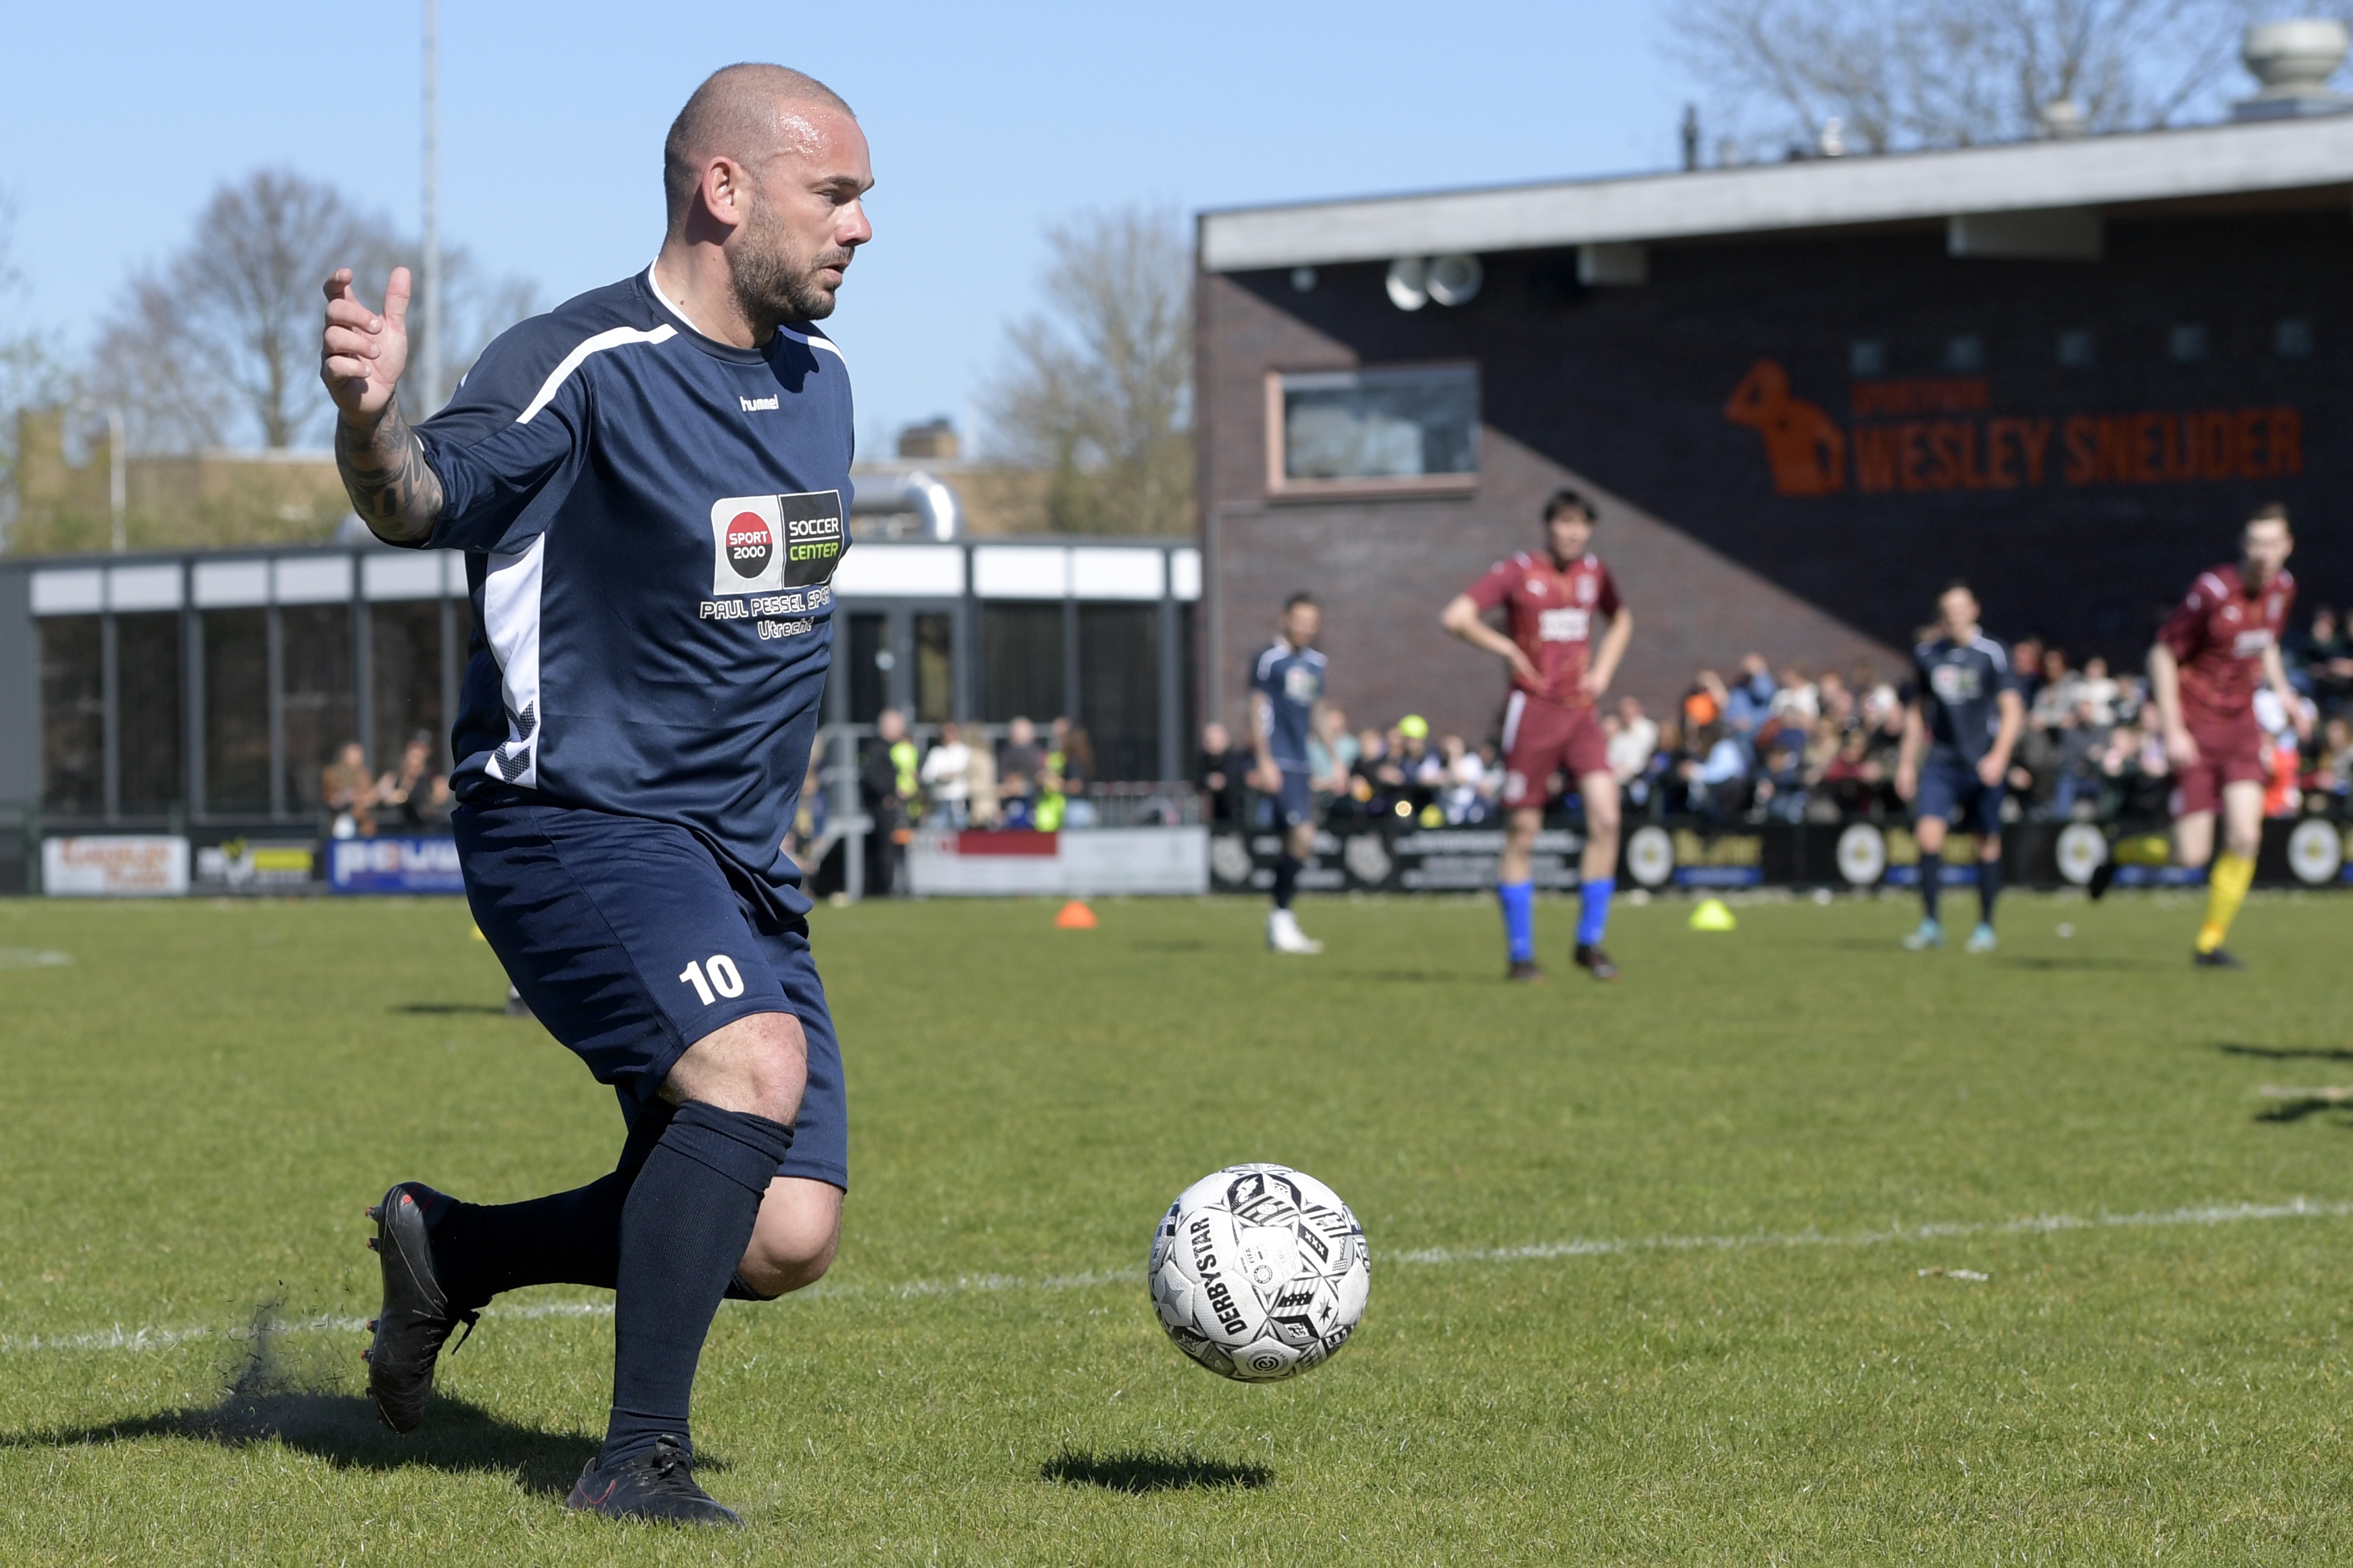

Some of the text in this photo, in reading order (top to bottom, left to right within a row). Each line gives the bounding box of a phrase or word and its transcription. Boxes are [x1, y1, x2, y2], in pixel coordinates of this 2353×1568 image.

[739, 394, 779, 411] hummel
[1853, 419, 2052, 491] WESLEY
[789, 517, 839, 536] SOCCER
[729, 530, 768, 546] SPORT
[733, 546, 765, 559] 2000
[790, 542, 838, 561] CENTER
[700, 599, 749, 620] PAUL
[752, 593, 806, 617] PESSEL
[758, 616, 815, 640] Utrecht
[679, 954, 744, 1006] 10
[1190, 1217, 1248, 1335] DERBYSTAR
